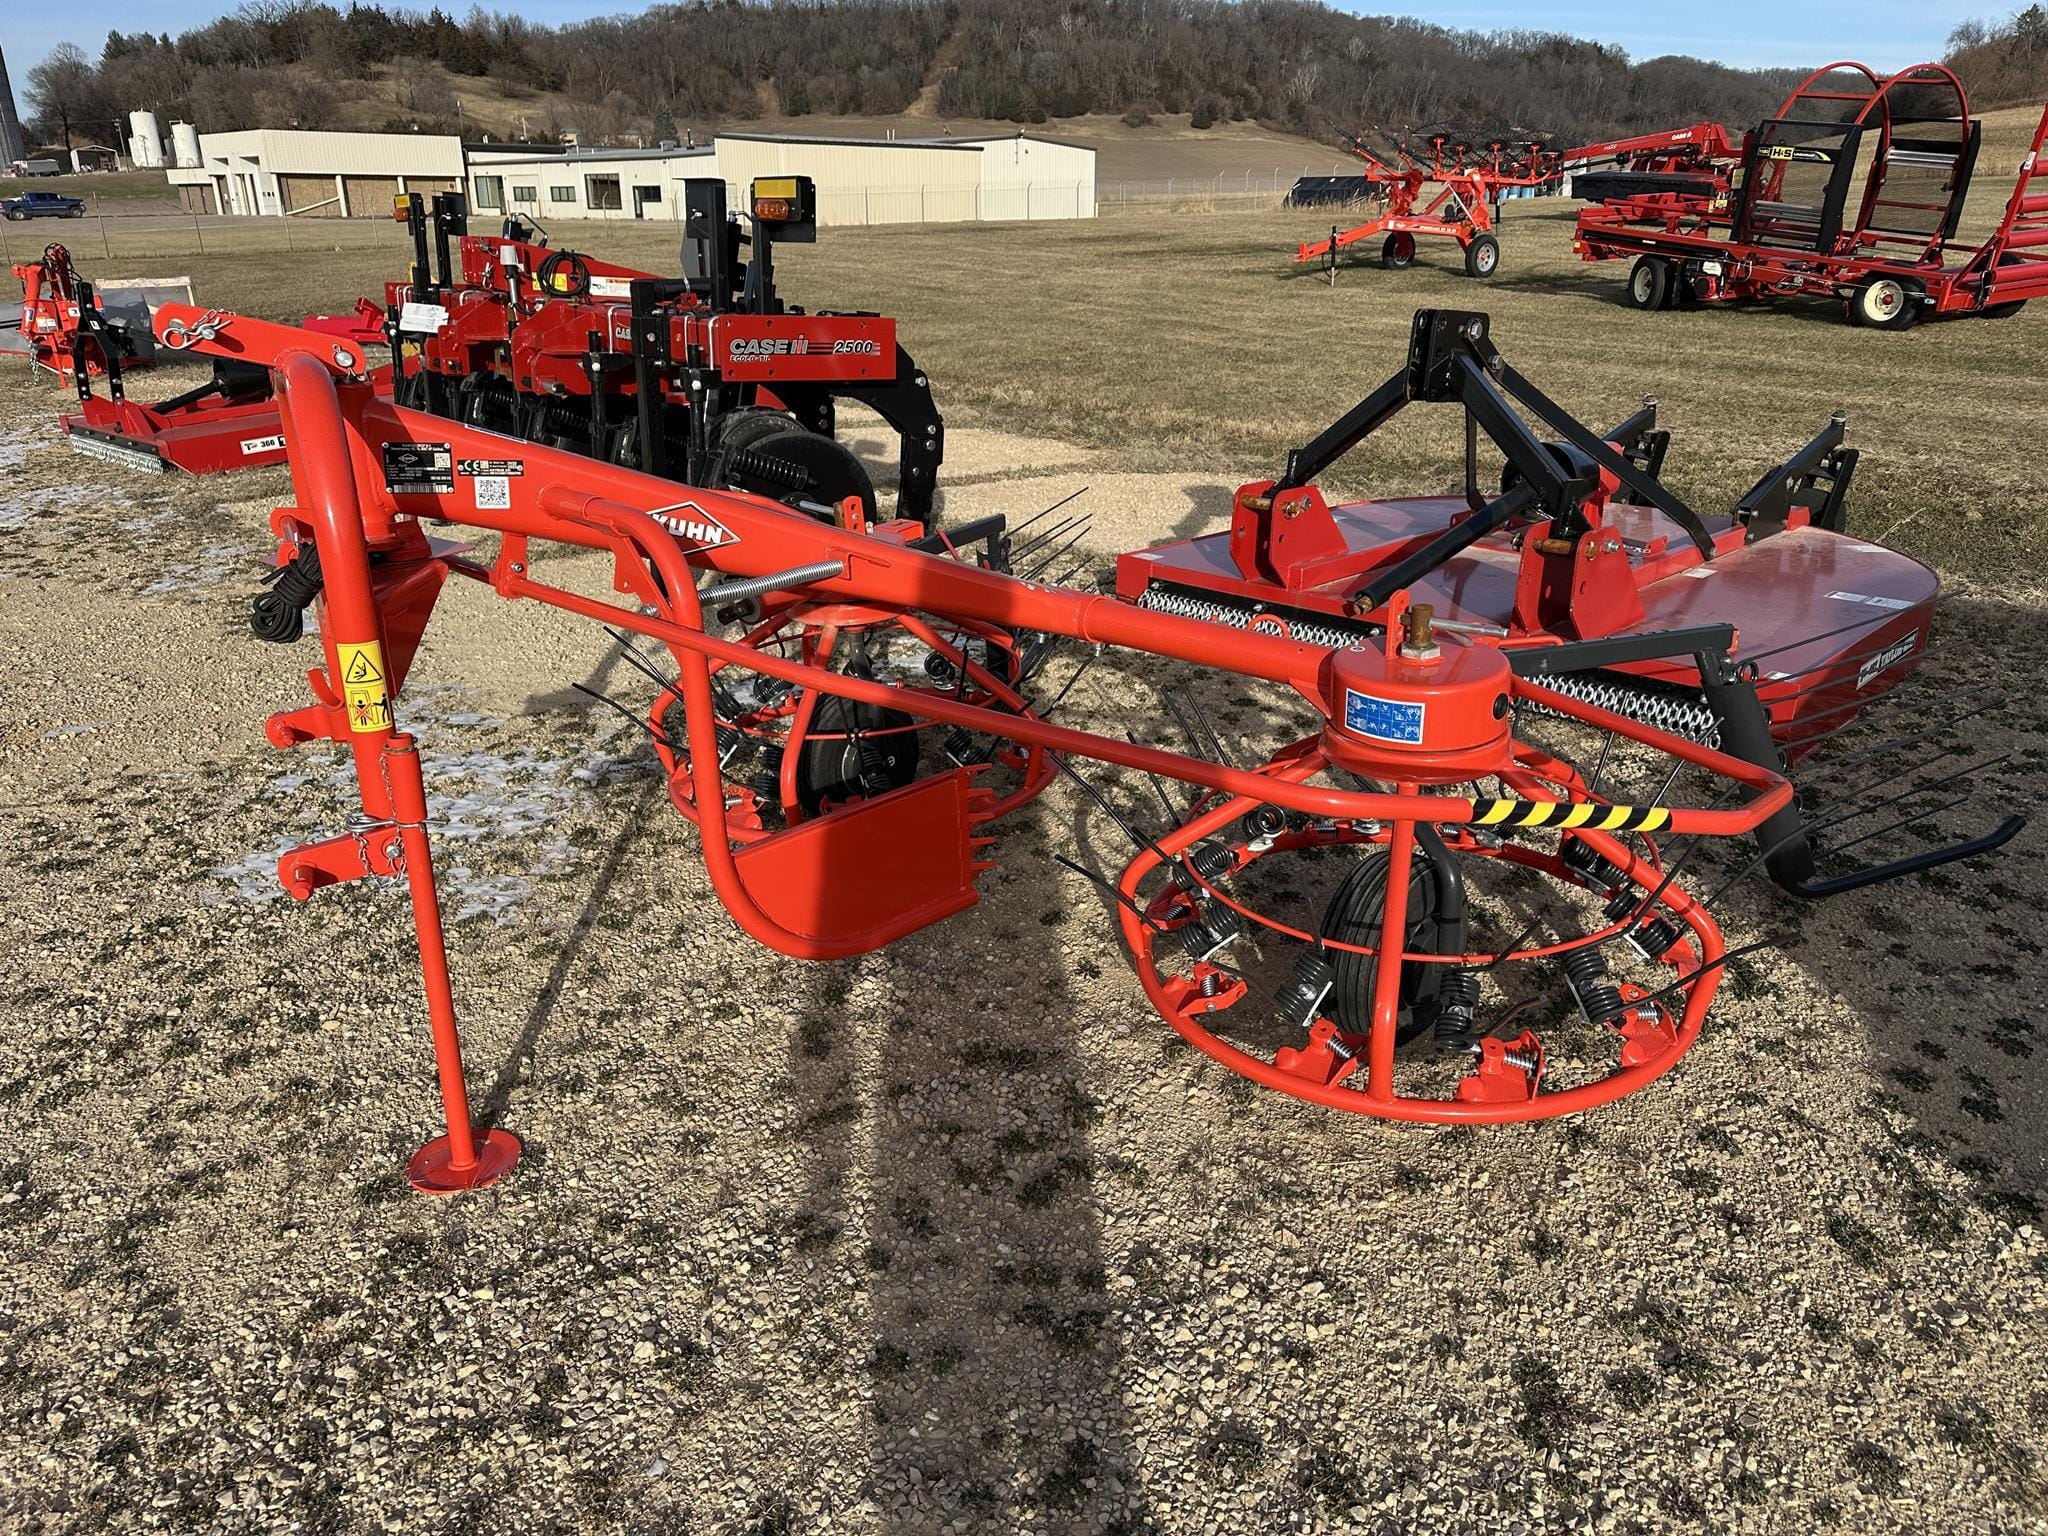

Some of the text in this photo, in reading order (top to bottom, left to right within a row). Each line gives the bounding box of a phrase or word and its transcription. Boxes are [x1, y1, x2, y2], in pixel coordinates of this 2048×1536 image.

[1772, 148, 1793, 158] H&S
[615, 326, 632, 341] CAS
[729, 338, 789, 355] CASE
[832, 339, 874, 355] 2500
